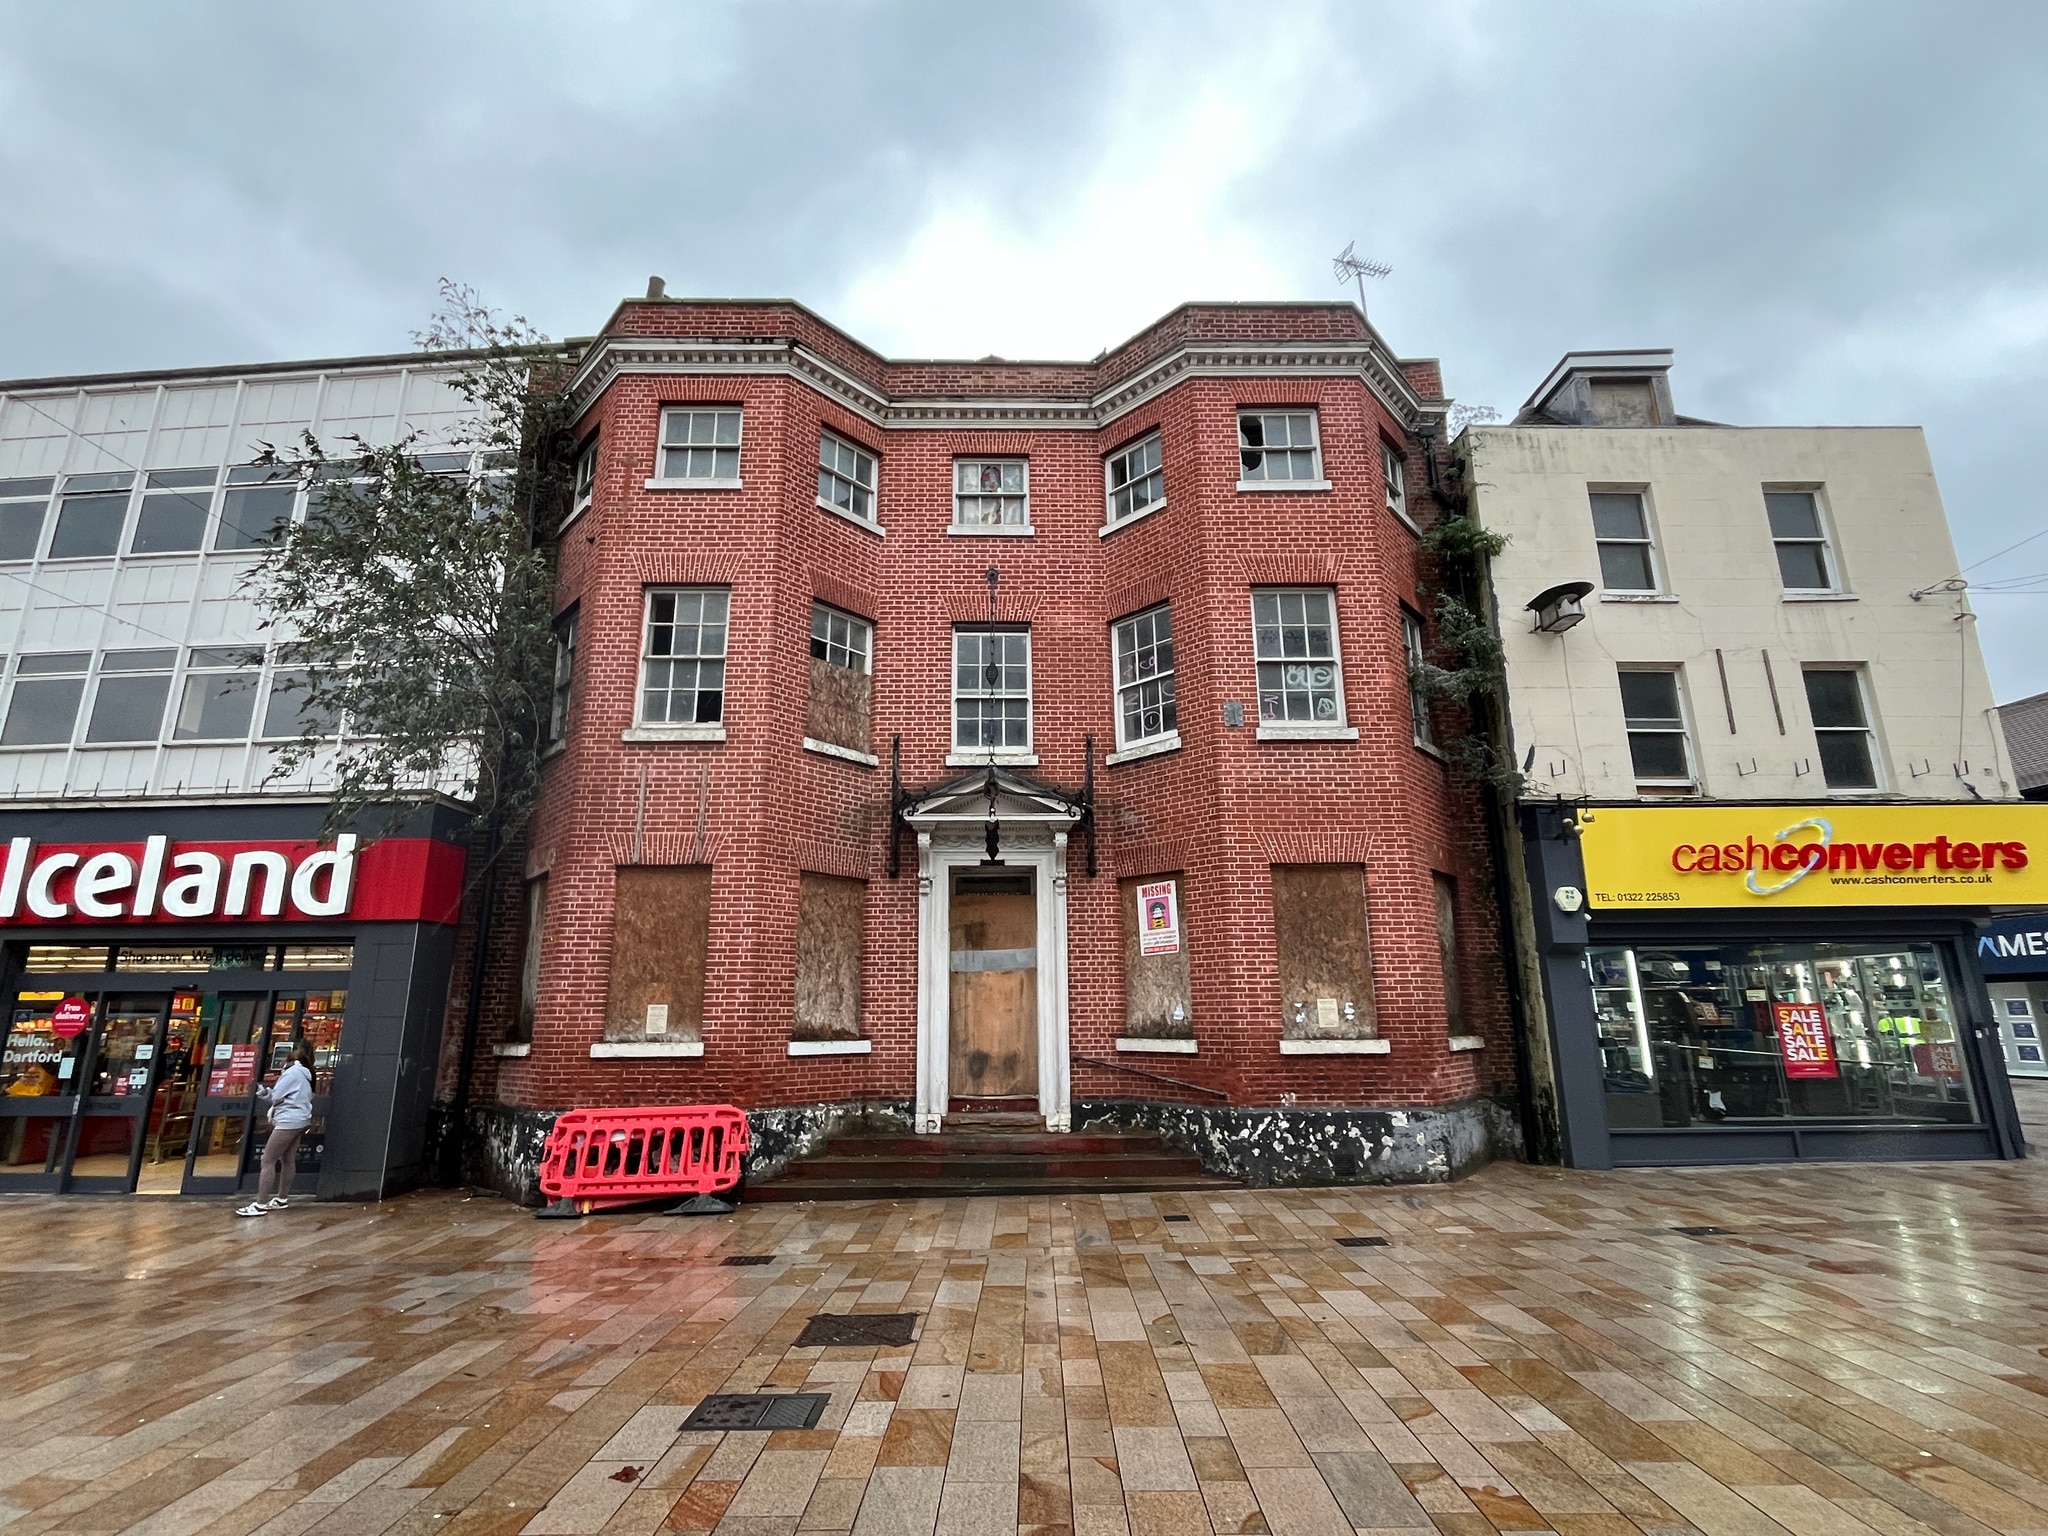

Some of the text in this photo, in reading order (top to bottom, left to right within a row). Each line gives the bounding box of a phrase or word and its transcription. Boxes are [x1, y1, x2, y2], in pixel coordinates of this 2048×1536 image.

[0, 833, 357, 918] Iceland
[1830, 873, 1993, 885] www.cashconverters.co.uk
[1141, 883, 1172, 898] MISSING
[1594, 892, 1681, 902] TEL: 01322 225853
[63, 1004, 82, 1012] Free
[54, 1011, 87, 1021] delivery
[1779, 1009, 1821, 1023] SALE
[1781, 1022, 1824, 1035] SALE
[1784, 1035, 1827, 1048] SALE
[2, 1050, 63, 1063] Dartford
[1786, 1048, 1830, 1061] SALE
